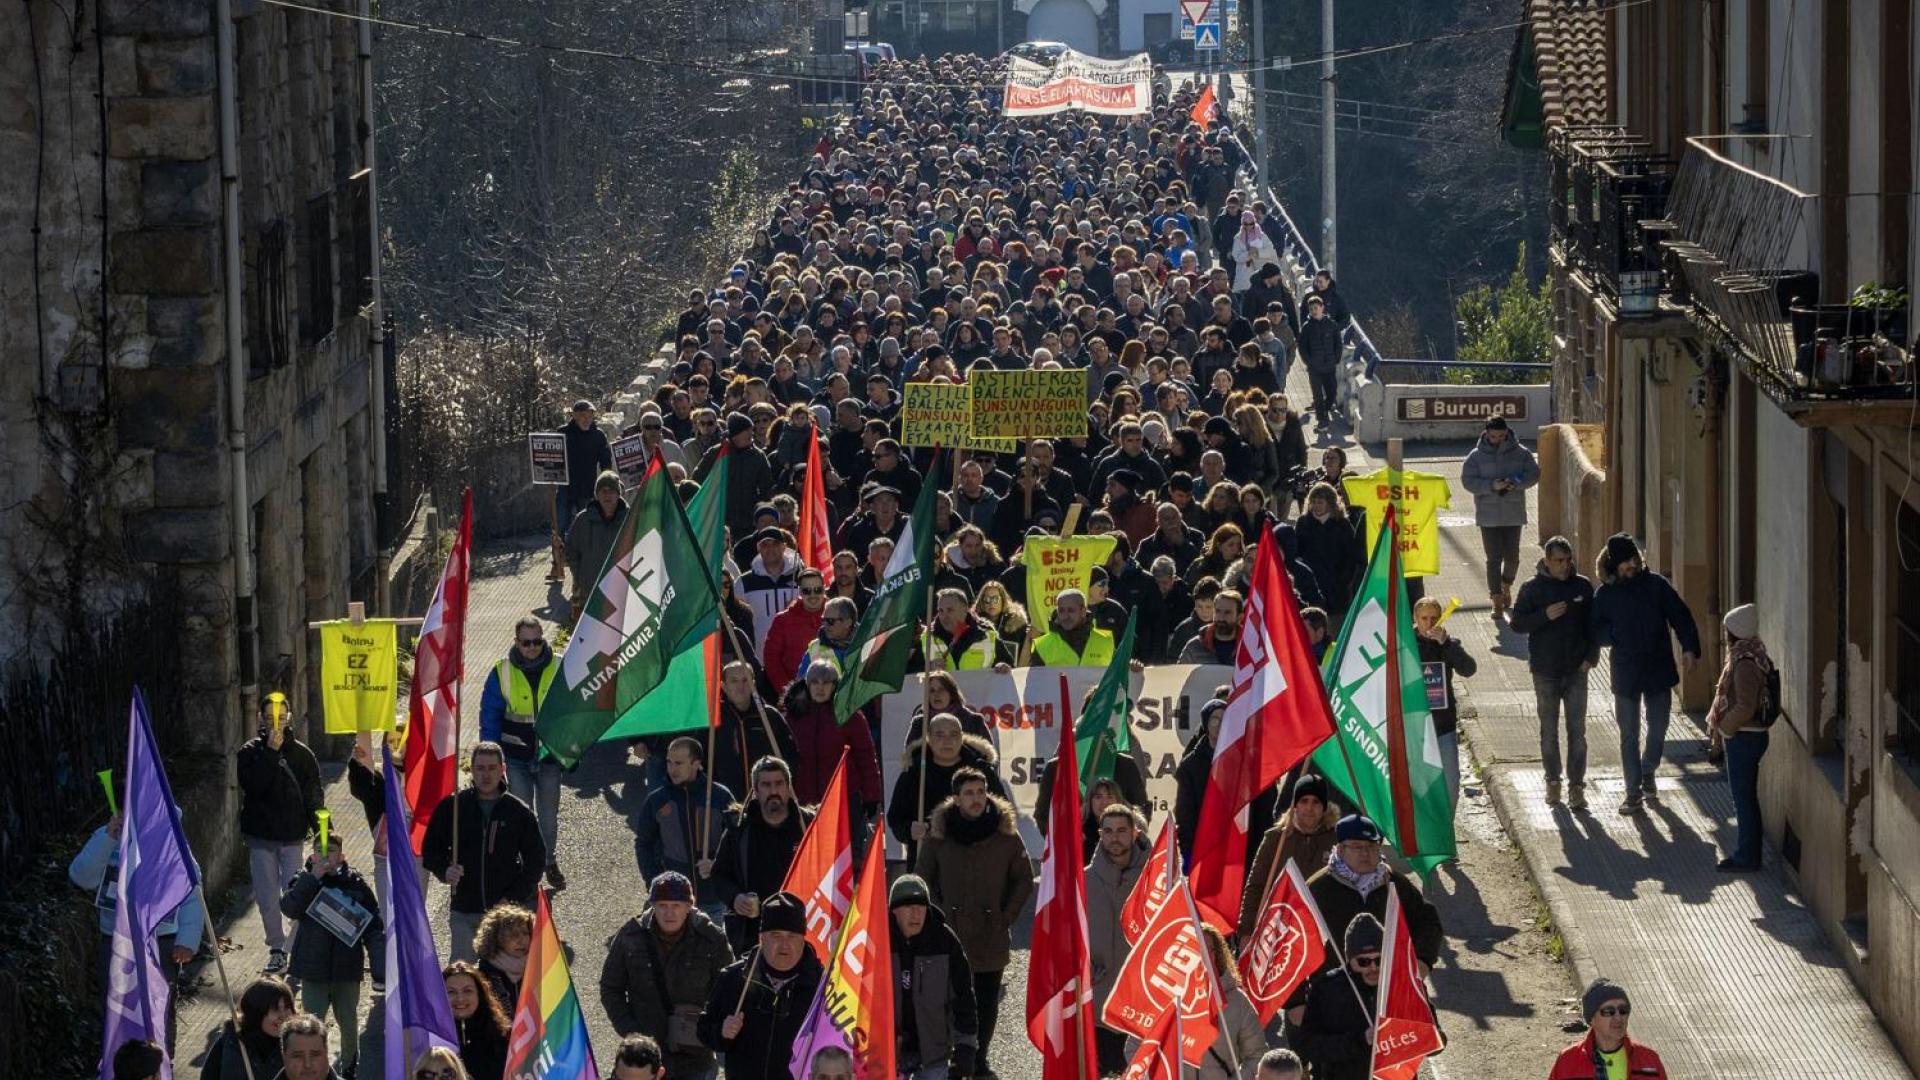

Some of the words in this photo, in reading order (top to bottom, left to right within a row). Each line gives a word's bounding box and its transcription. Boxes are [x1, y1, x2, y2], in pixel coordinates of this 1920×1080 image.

[1009, 90, 1047, 105] KLASE
[976, 371, 1082, 386] ASTILLEROS
[1434, 400, 1517, 416] Burunda
[974, 411, 1084, 426] ELKARTASUNA
[975, 425, 999, 436] ETA
[1015, 424, 1083, 437] INDARRA
[906, 433, 931, 445] ETA
[944, 436, 1013, 451] INDARRA
[1376, 485, 1419, 500] BSH
[1041, 548, 1079, 566] BSH
[1045, 578, 1065, 592] NO
[348, 653, 368, 669] EZ
[1344, 717, 1391, 779] SINDIK
